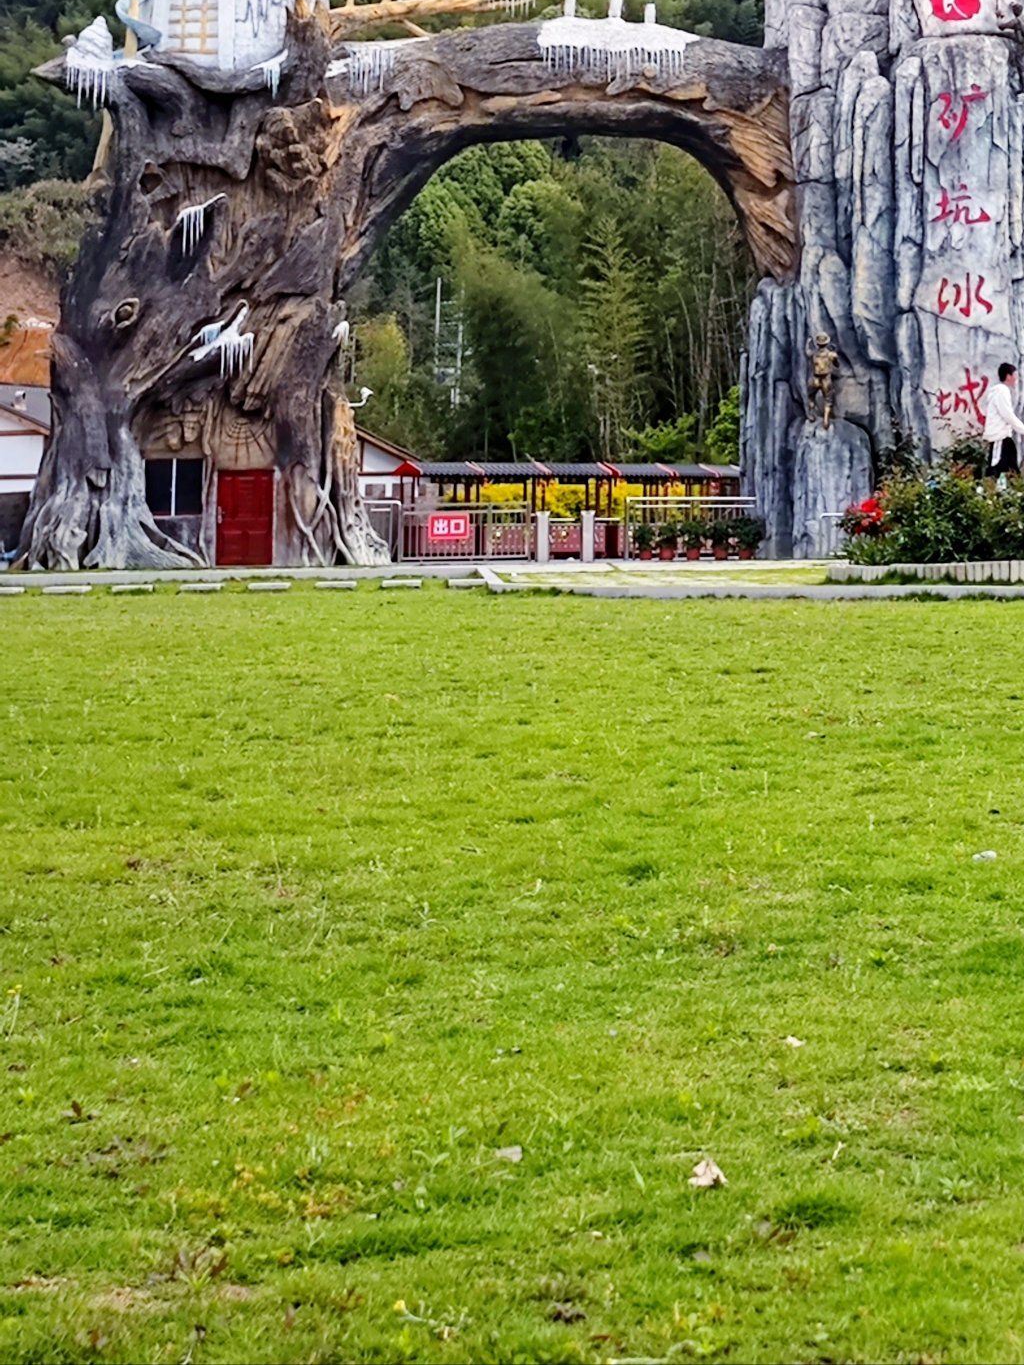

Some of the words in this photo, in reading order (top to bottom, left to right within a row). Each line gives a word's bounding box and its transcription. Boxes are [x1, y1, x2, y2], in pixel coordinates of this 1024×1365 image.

[930, 83, 993, 427] 矿坑冰城
[433, 518, 465, 534] 出口
